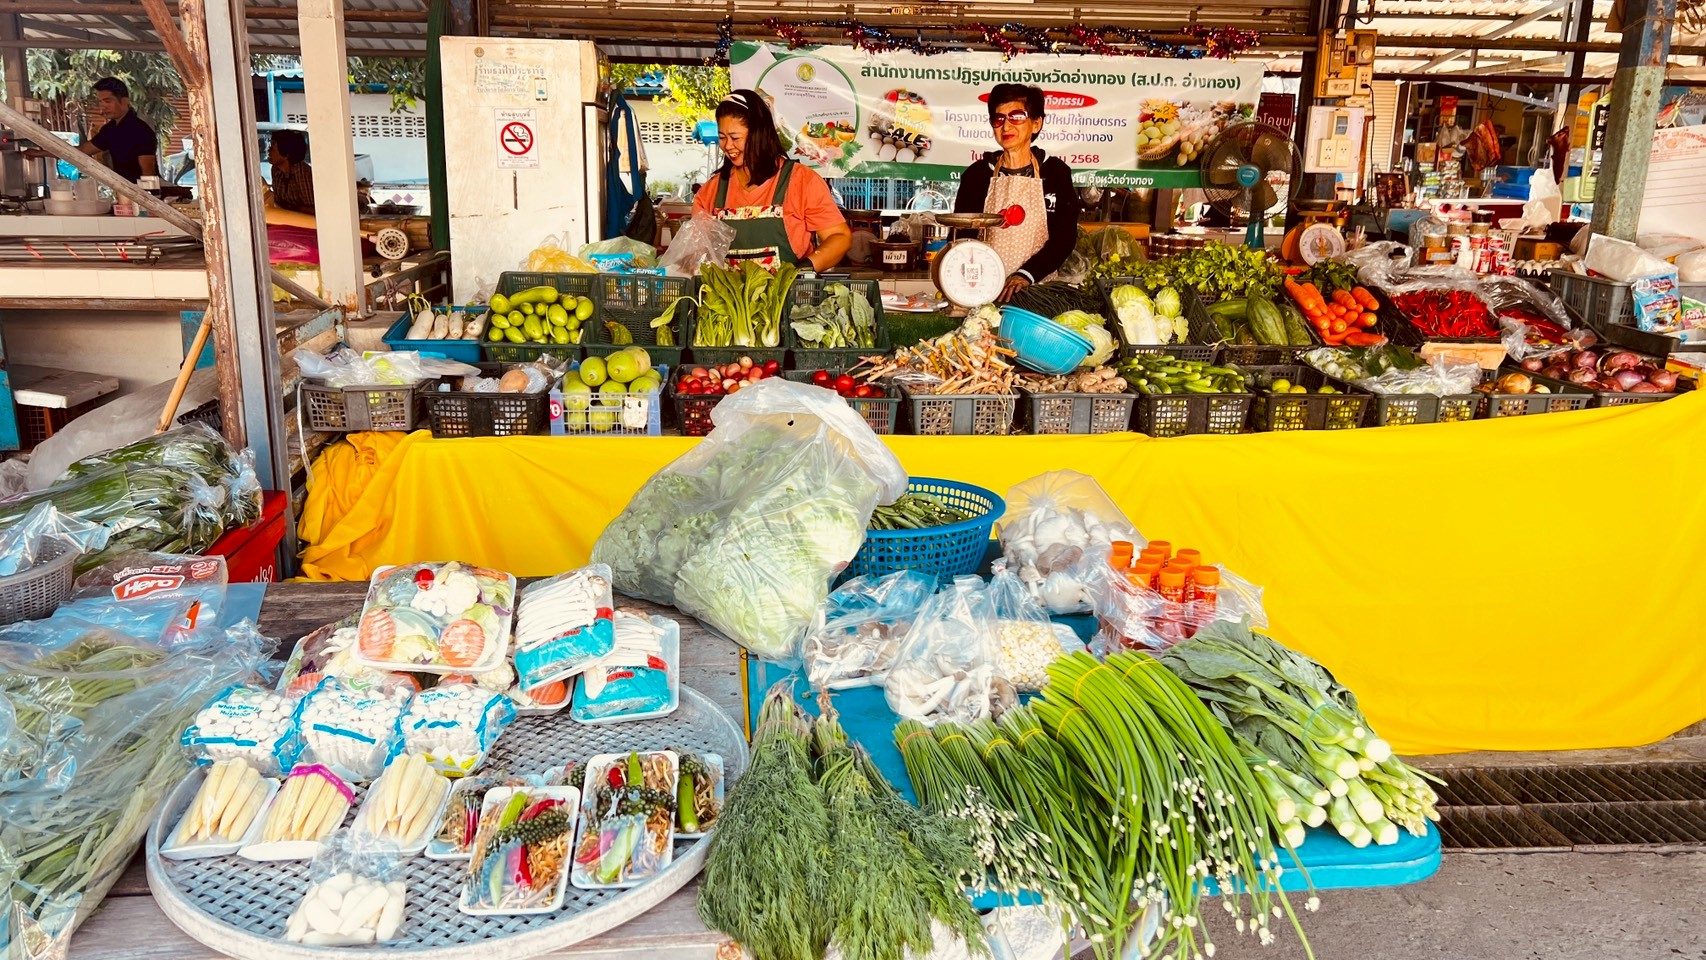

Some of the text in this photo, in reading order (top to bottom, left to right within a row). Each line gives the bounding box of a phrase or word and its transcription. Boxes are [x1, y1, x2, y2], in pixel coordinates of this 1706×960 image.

[861, 62, 1241, 90] สำนักงานการปฏิรูปที่ดินจังหวัดอ่างทอง (ส.ป.ก. อ่างทอง)
[1039, 129, 1114, 142] จังหวัดอ่างทอง
[1070, 154, 1100, 164] 2568
[122, 578, 175, 598] Hero
